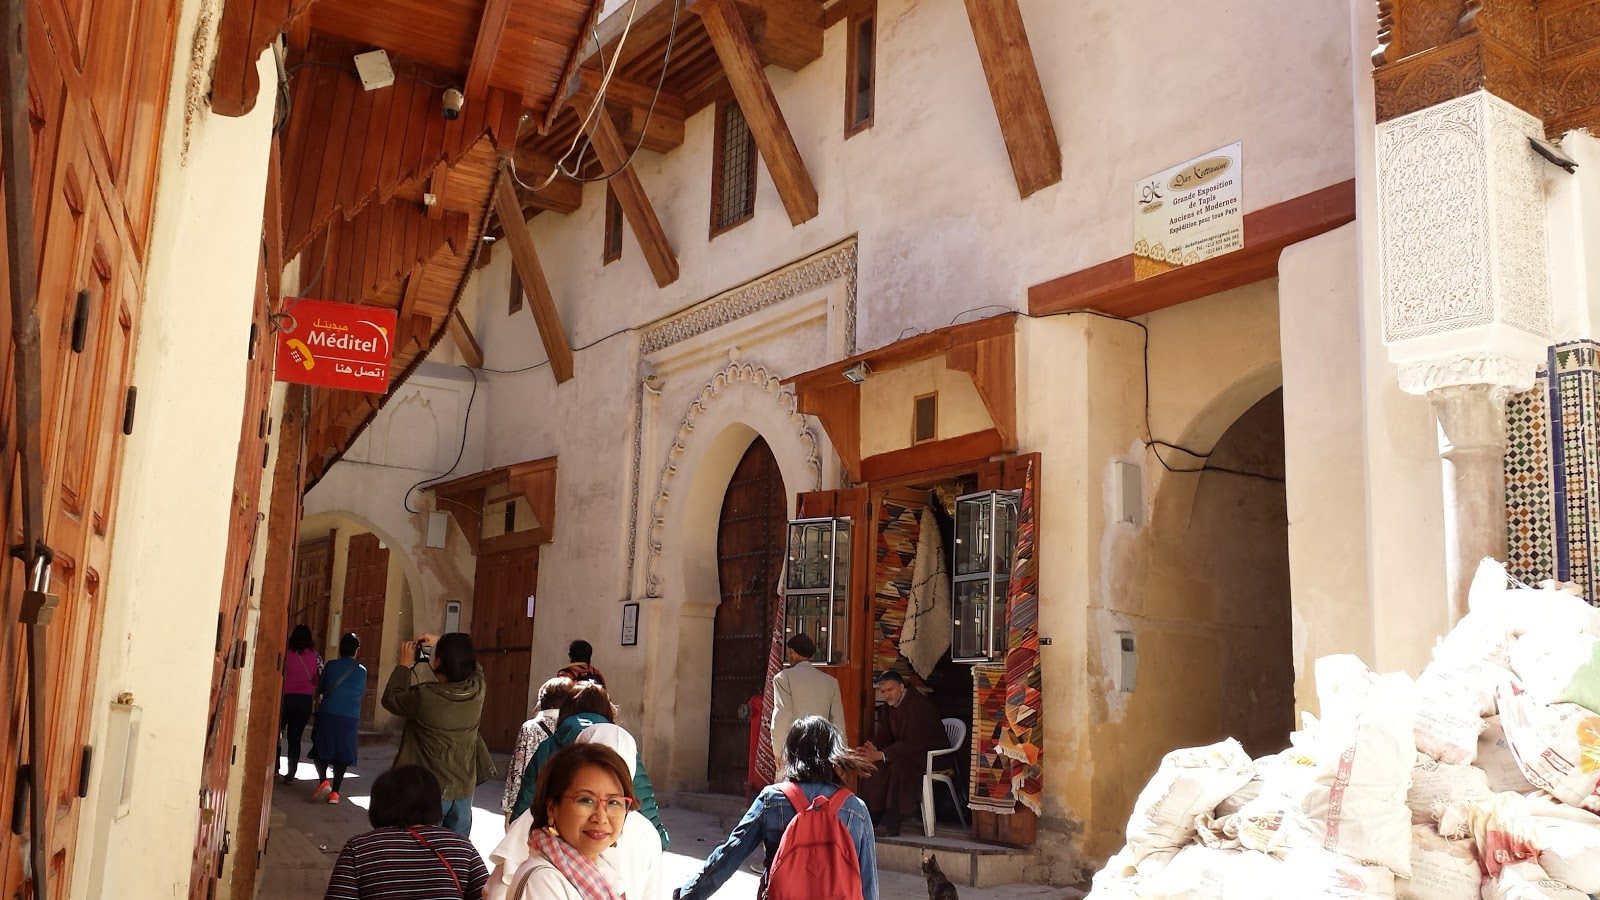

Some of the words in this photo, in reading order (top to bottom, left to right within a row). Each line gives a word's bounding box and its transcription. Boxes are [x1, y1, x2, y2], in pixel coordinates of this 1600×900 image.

[1174, 174, 1192, 186] Dar
[1172, 194, 1196, 205] Grande
[1197, 179, 1233, 196] Exposition
[1188, 201, 1197, 209] de
[1198, 194, 1216, 206] Tapis
[1169, 212, 1195, 225] Anciens
[1205, 197, 1237, 212] Modernes
[1169, 220, 1197, 235] Expédition
[1198, 216, 1211, 226] pour
[1212, 212, 1224, 220] tous
[1225, 206, 1238, 217] Pays
[307, 330, 377, 352] Méditel
[335, 362, 352, 373] هنا
